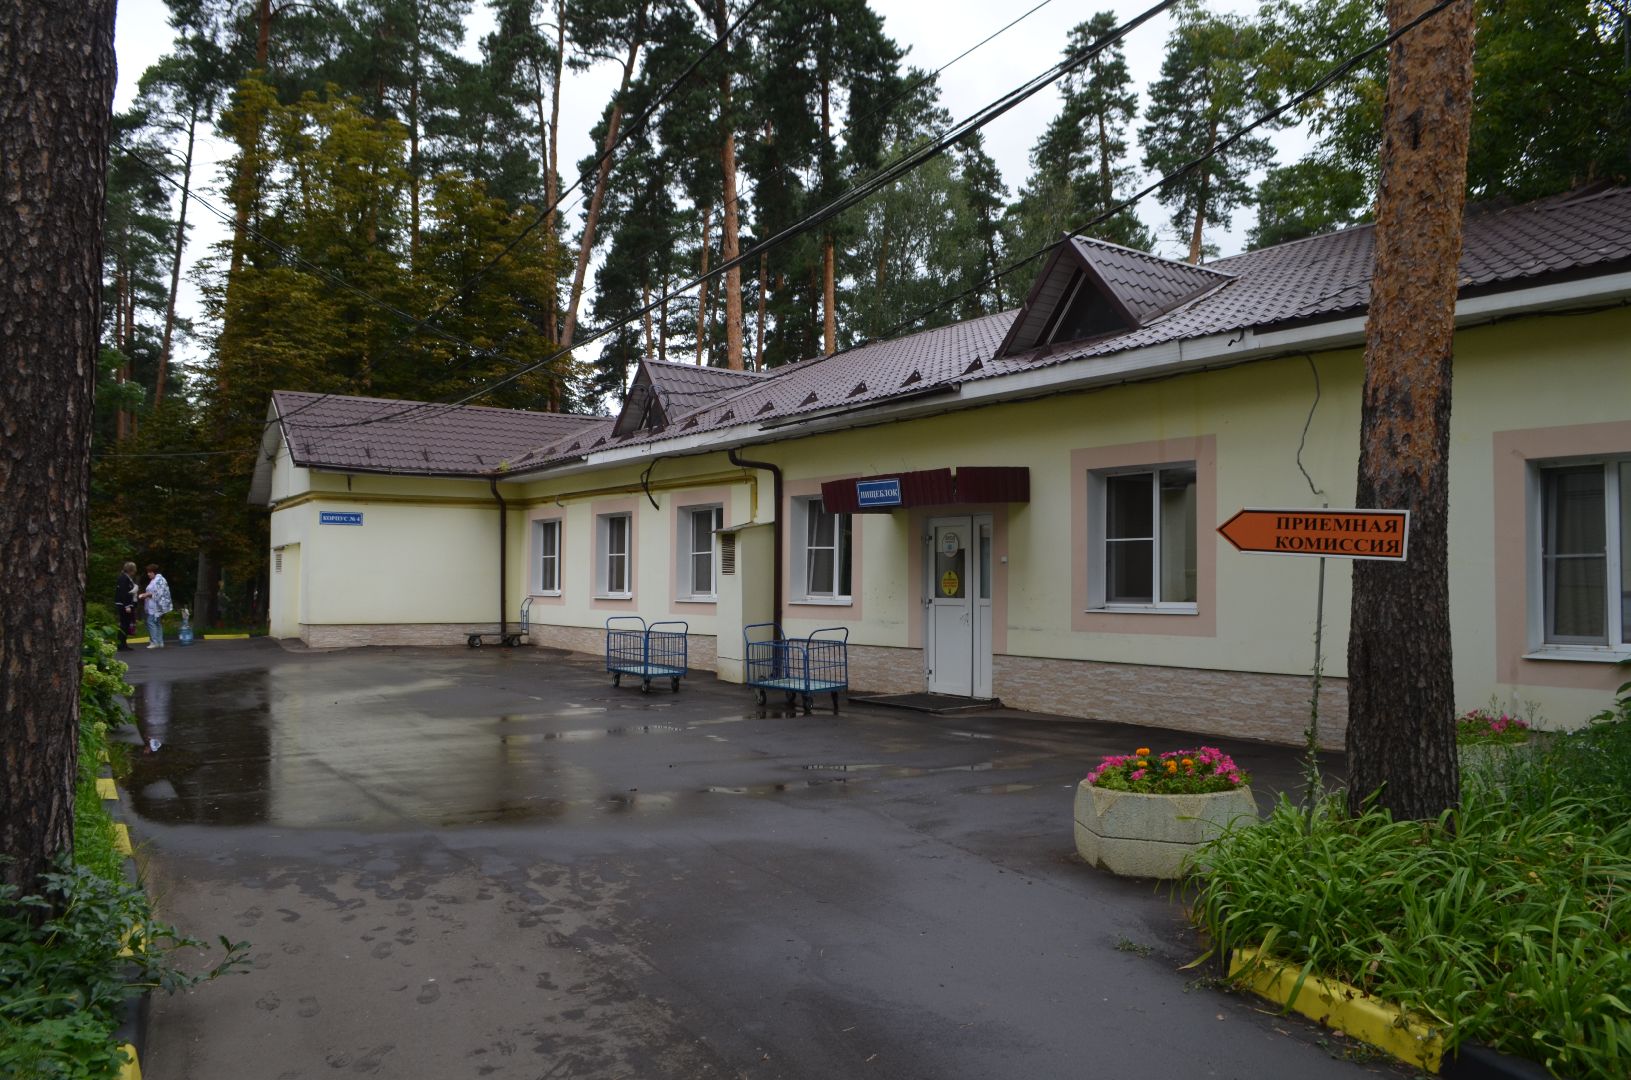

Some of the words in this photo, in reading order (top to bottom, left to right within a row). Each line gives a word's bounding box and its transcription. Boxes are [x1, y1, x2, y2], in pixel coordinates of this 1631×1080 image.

[860, 489, 898, 499] ПИЩЕБЛОК
[1276, 517, 1398, 533] ПРИЕМНАЯ
[1275, 536, 1399, 553] КОМИССИЯ
